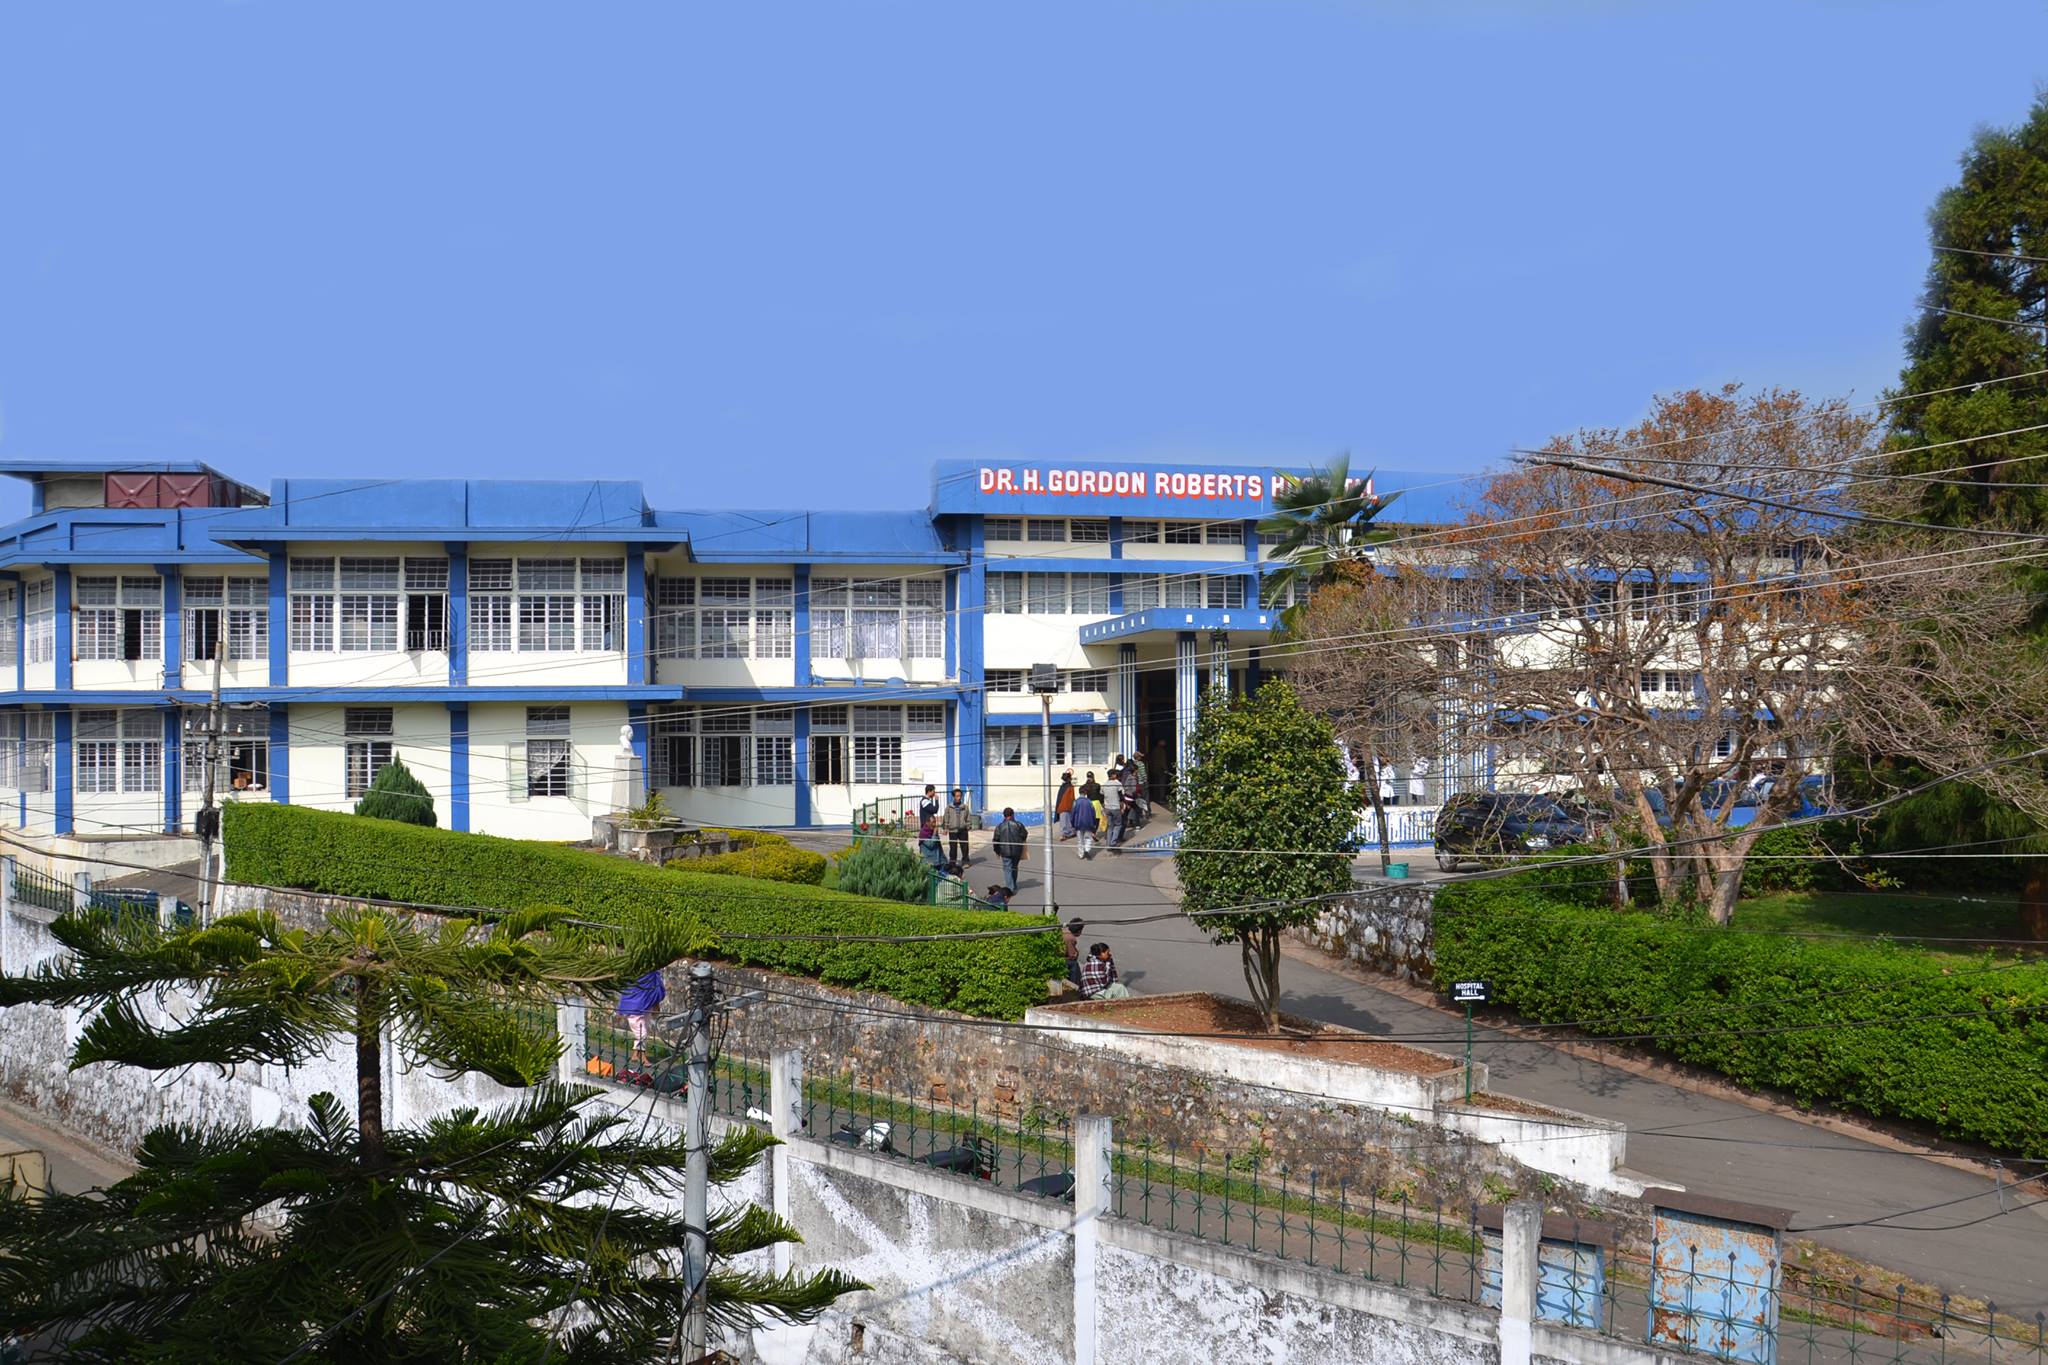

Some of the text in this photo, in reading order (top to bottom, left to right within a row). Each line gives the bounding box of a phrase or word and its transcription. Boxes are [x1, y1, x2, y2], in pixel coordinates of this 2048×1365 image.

[979, 468, 1021, 495] DR.
[1023, 469, 1047, 496] H.
[1048, 470, 1147, 497] GORDON
[1155, 472, 1263, 500] ROBERTS
[1455, 982, 1485, 990] HOSPITAL
